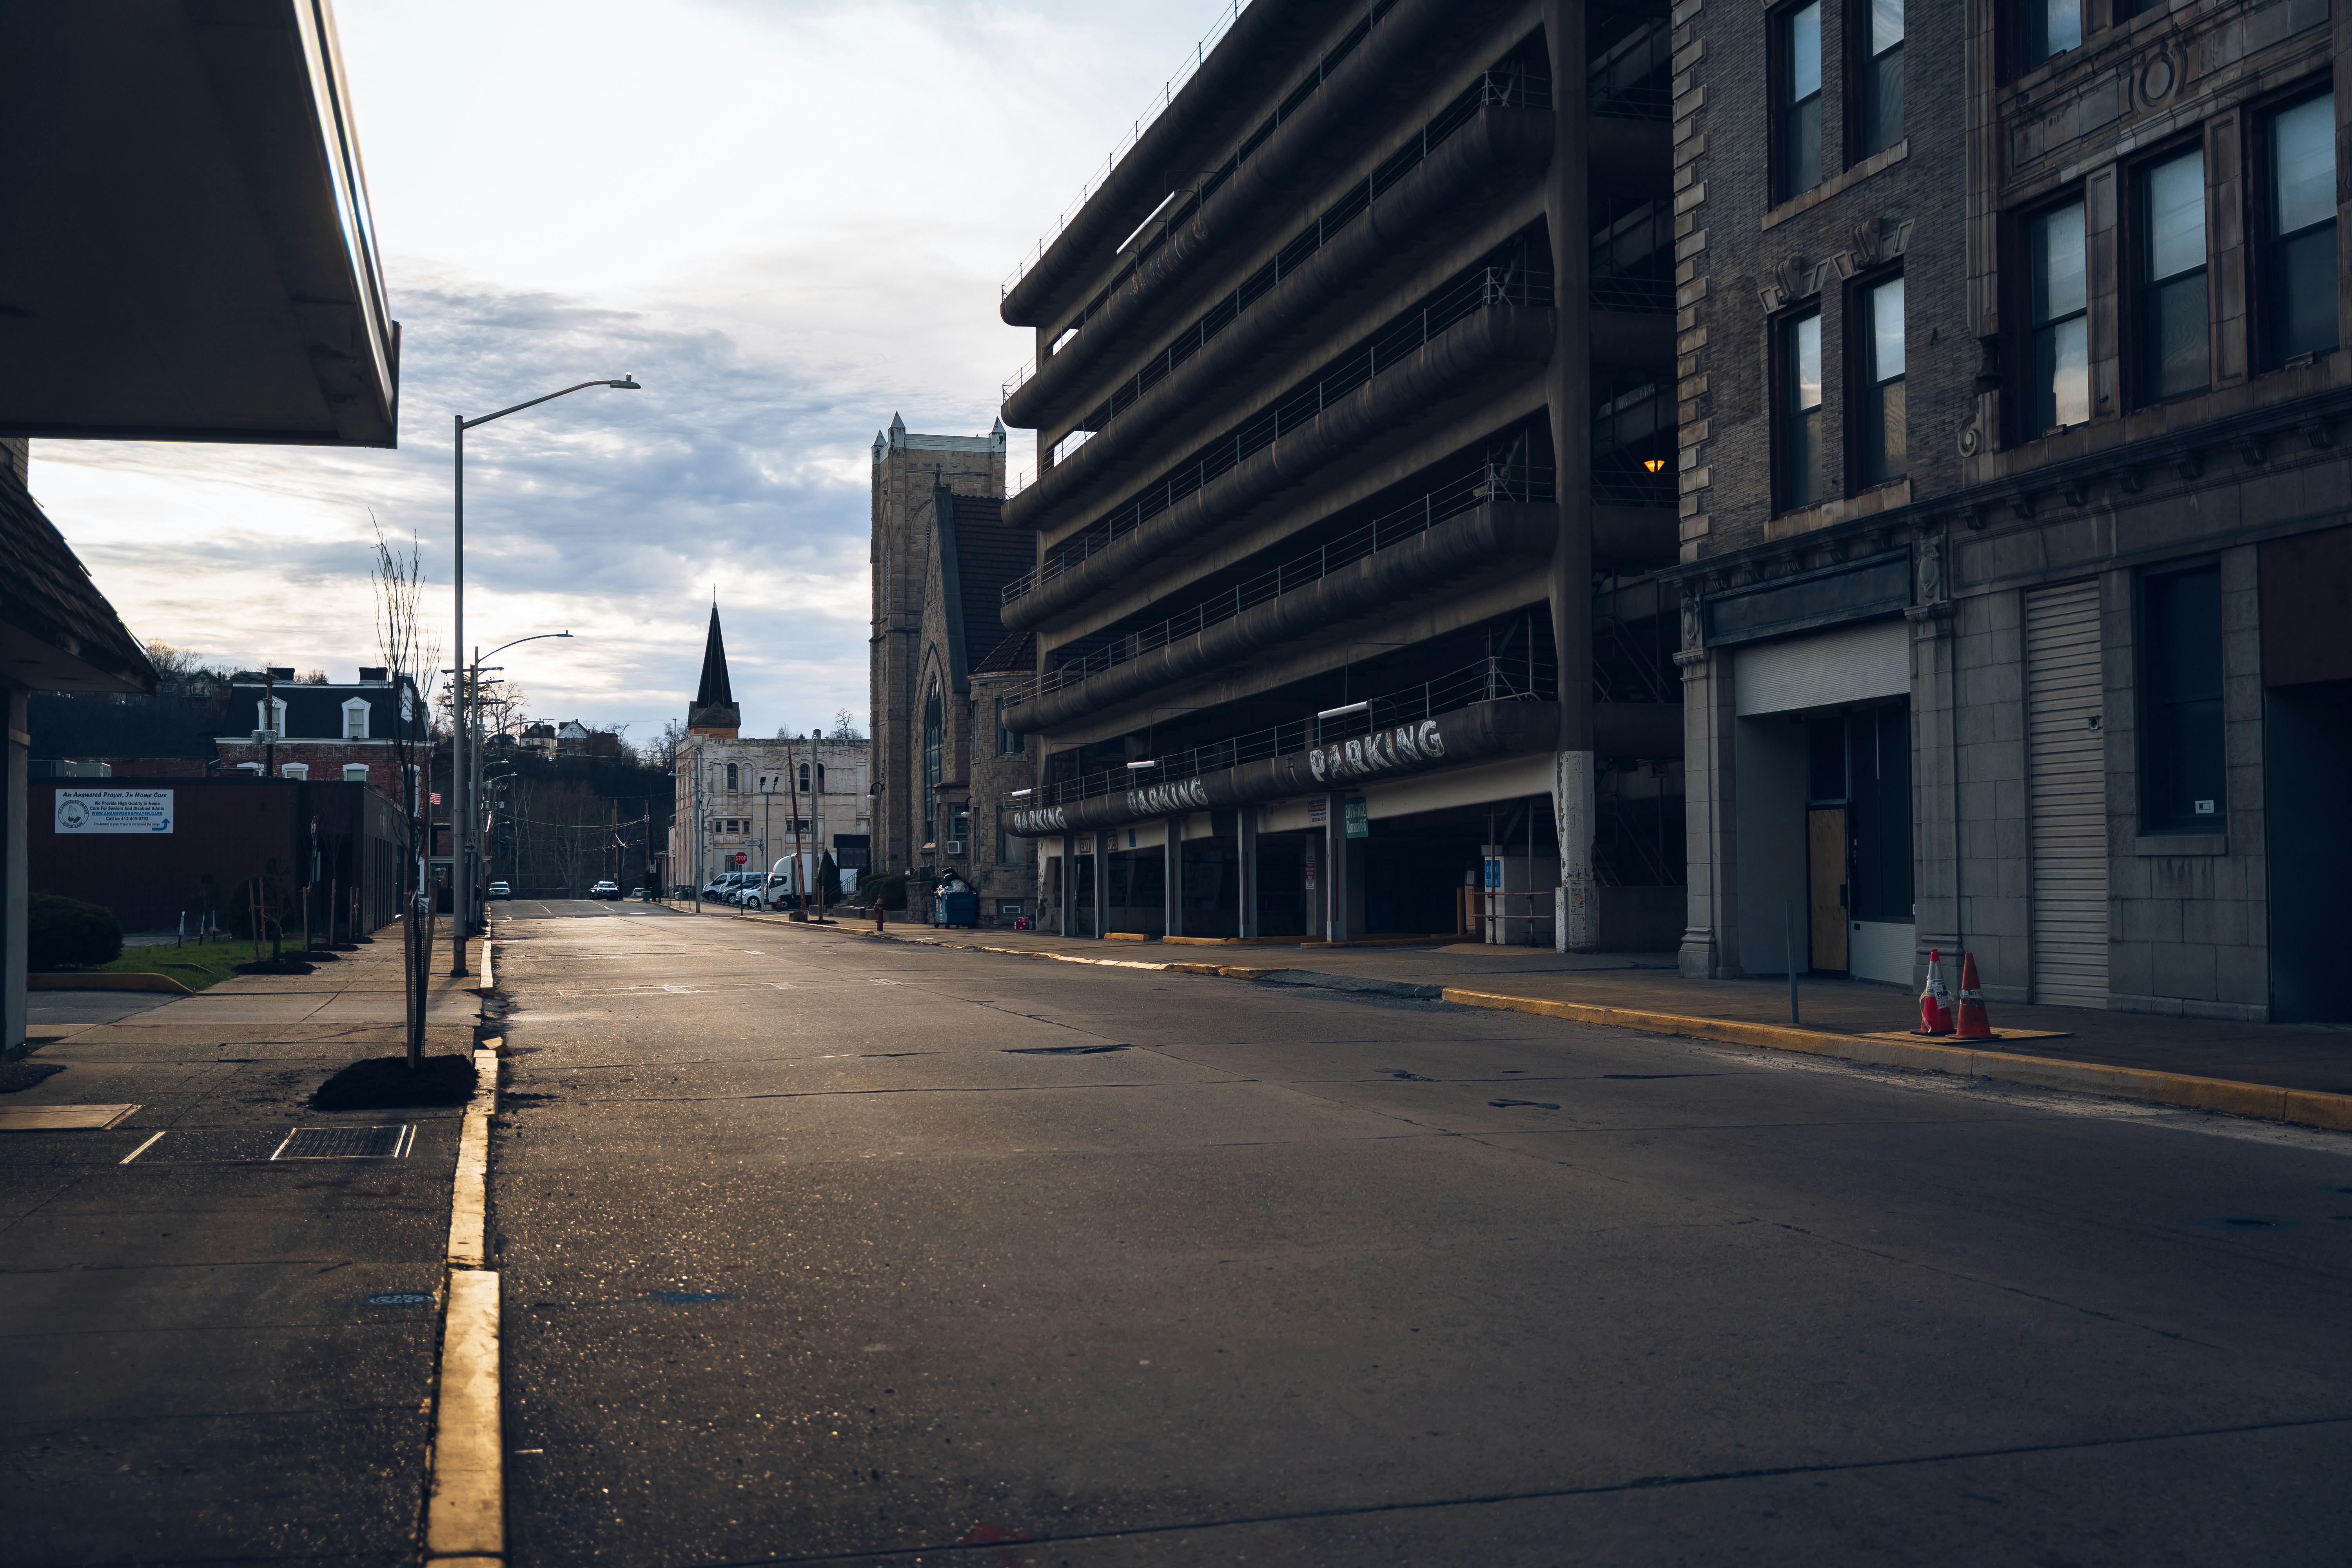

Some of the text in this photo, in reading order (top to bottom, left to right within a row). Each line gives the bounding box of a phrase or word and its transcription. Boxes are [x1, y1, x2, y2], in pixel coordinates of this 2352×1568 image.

[1310, 720, 1445, 782] PARKING
[1127, 778, 1209, 816] PARKING
[61, 800, 80, 809] ANSWERED
[80, 802, 88, 814] PRAYER
[1345, 802, 1366, 819] ENTRANCE
[1014, 806, 1068, 833] PARKING
[1081, 839, 1090, 851] EXIT
[1107, 837, 1118, 850] NTER
